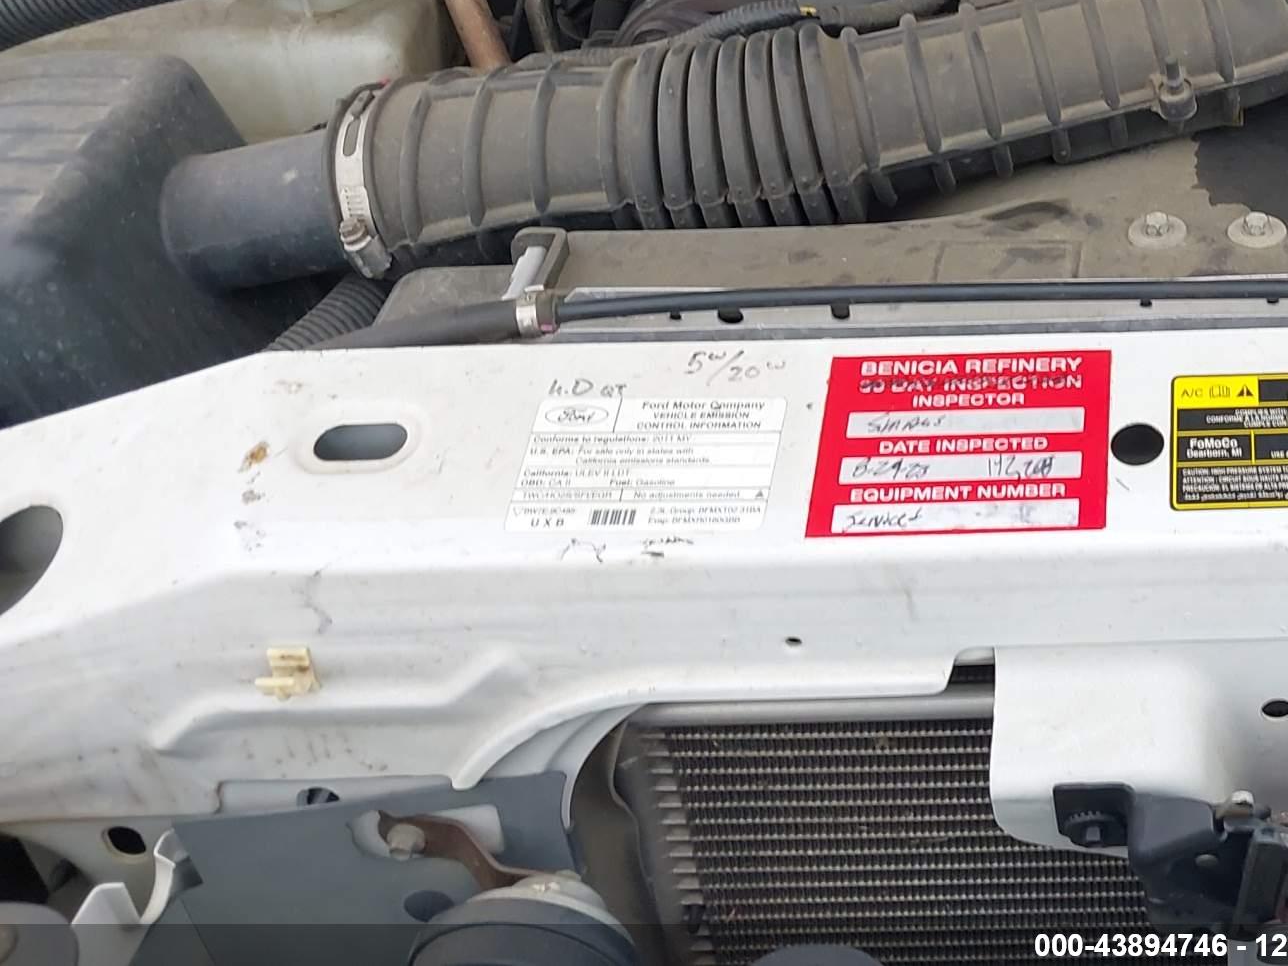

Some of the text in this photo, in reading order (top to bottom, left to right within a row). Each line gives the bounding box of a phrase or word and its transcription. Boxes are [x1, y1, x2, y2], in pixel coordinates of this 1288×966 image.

[861, 357, 1082, 376] BENICIA REFINERY
[891, 378, 937, 392] DAY
[944, 375, 1082, 391] INSPECTION
[912, 392, 1025, 408] INSPECTOR
[1181, 388, 1203, 398] A/C
[642, 400, 765, 412] Ford Motor Company
[636, 421, 761, 430] CONTROL INFORMATION
[879, 437, 1048, 454] DATE INSPECTED
[1190, 437, 1238, 449] FoMoCo
[1231, 447, 1242, 457] MI
[850, 483, 1066, 502] EQUIPMENT NUMBER
